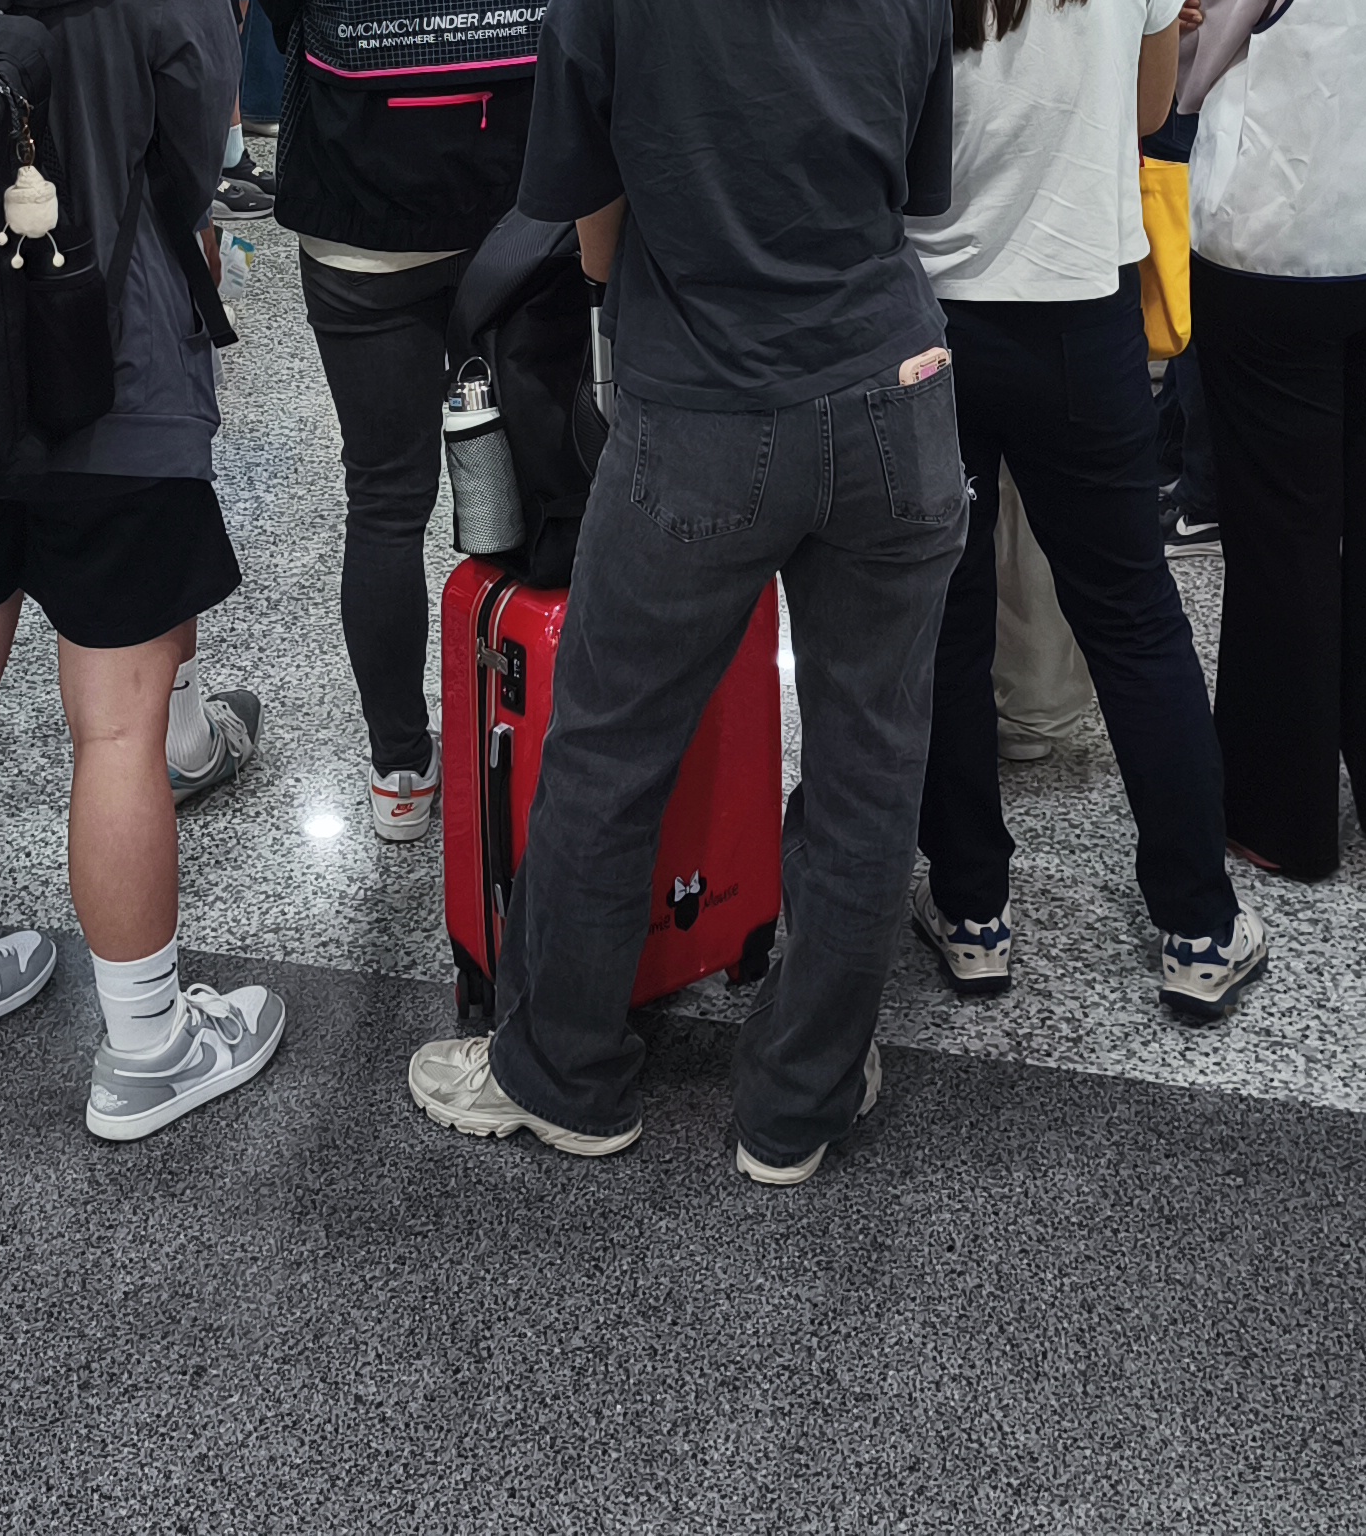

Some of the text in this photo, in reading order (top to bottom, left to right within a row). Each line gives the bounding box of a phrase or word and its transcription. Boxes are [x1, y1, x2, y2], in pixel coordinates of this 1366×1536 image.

[423, 13, 479, 30] UNDER
[358, 39, 380, 49] RUN
[382, 34, 437, 48] ANYWHERE
[444, 31, 466, 42] RUN
[467, 25, 528, 40] EVERYWHERE
